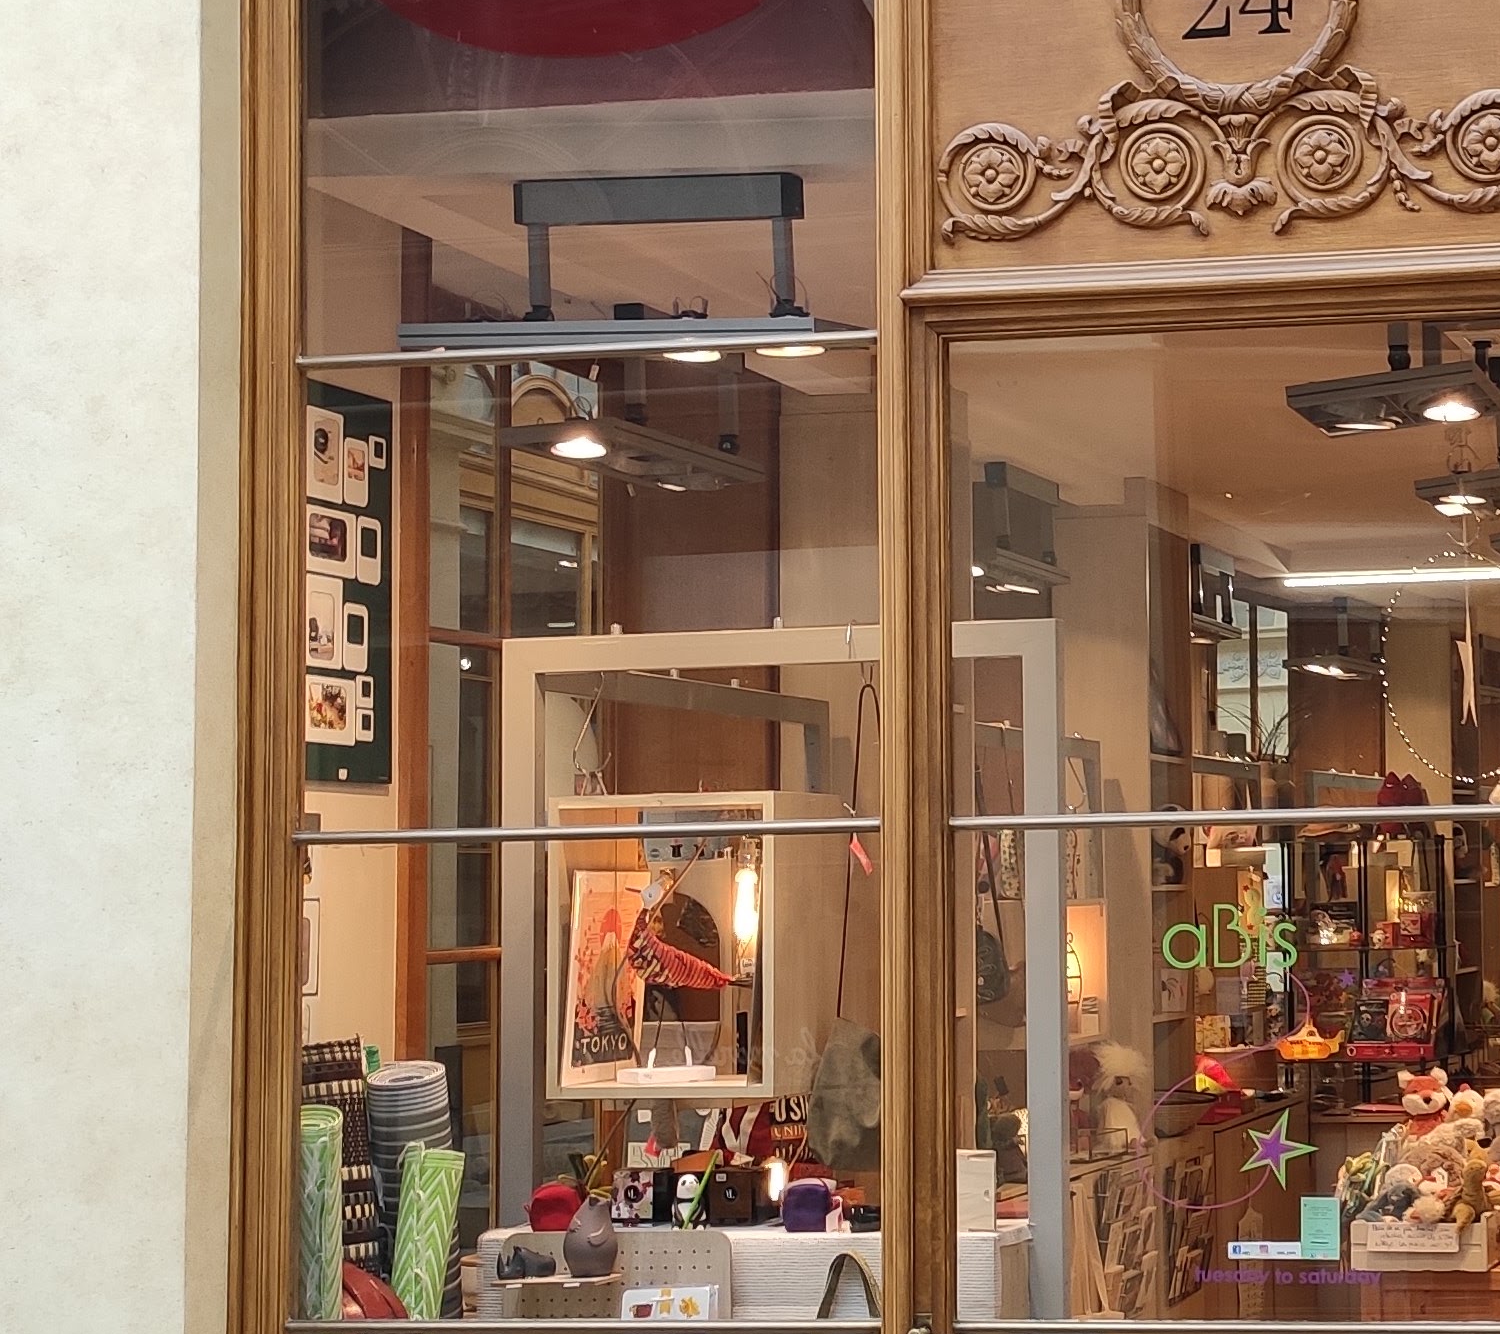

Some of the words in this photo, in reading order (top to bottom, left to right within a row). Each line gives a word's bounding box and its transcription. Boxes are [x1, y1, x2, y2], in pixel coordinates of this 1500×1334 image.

[1162, 903, 1299, 970] aBis
[580, 1033, 628, 1055] TOKYO
[1195, 1266, 1271, 1284] tuesday
[1276, 1268, 1293, 1285] to
[1298, 1268, 1381, 1286] saturday
